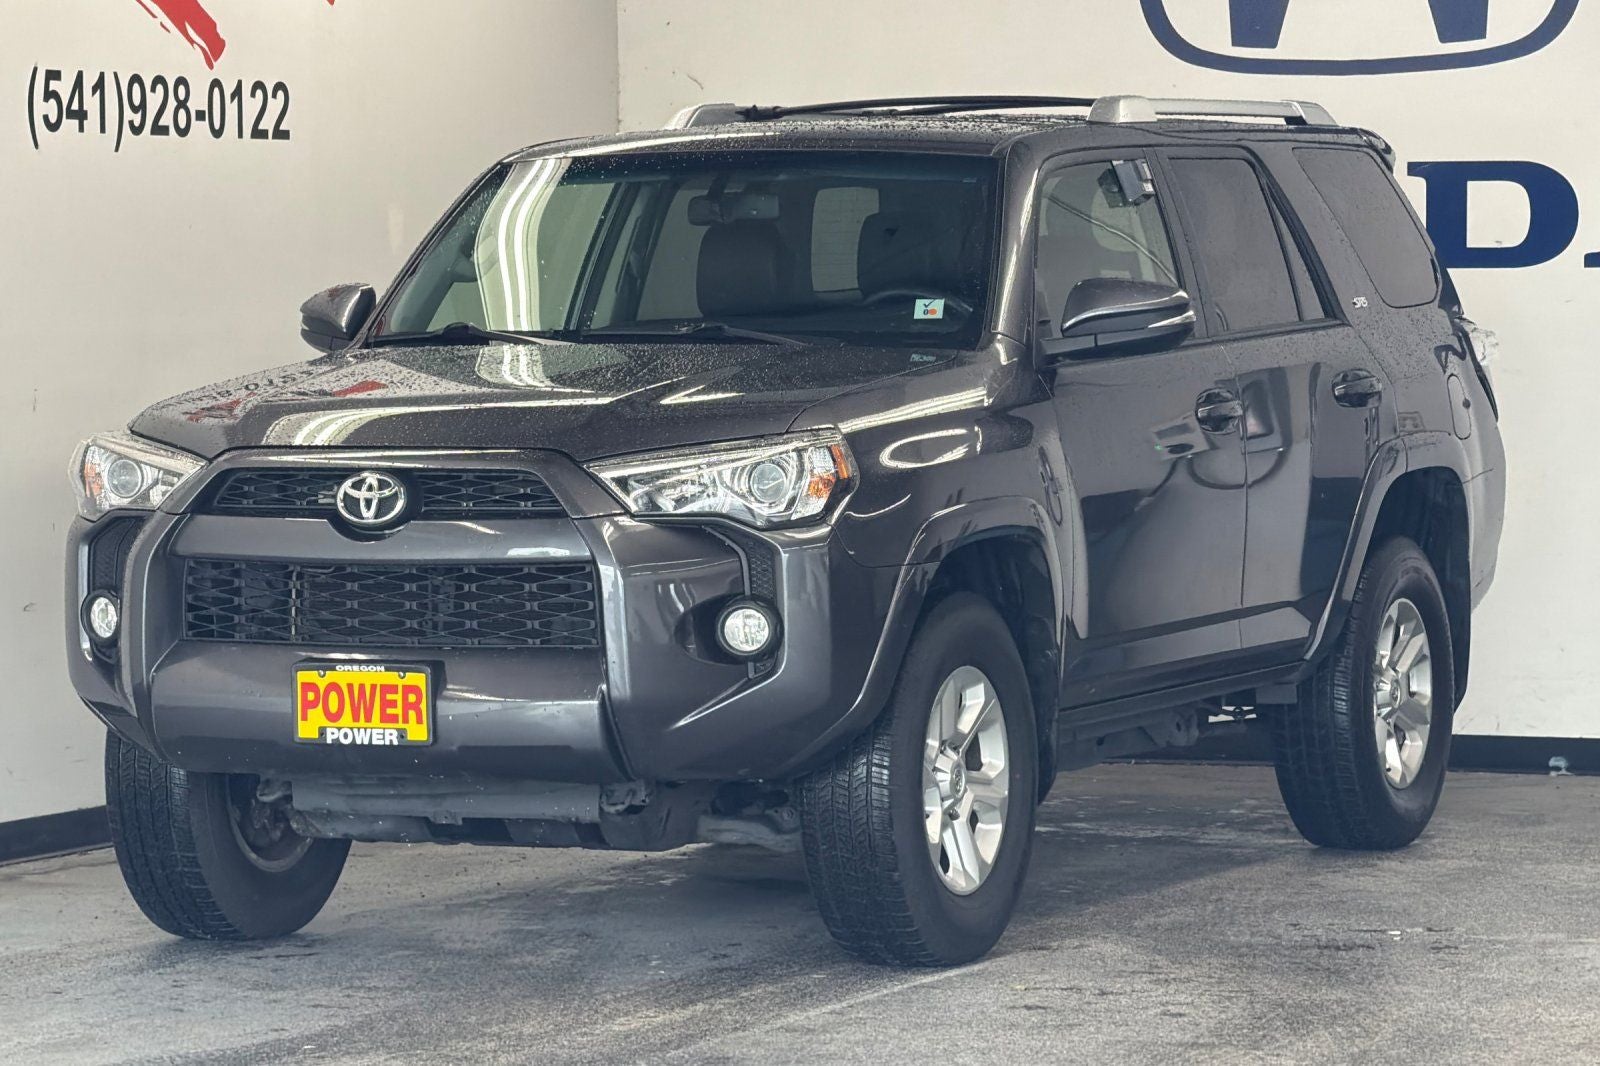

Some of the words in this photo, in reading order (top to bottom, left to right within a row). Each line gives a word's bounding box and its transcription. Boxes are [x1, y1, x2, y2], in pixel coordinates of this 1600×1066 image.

[28, 66, 291, 152] (541)928-0122
[300, 682, 423, 725] POWER
[326, 727, 399, 745] POWER
